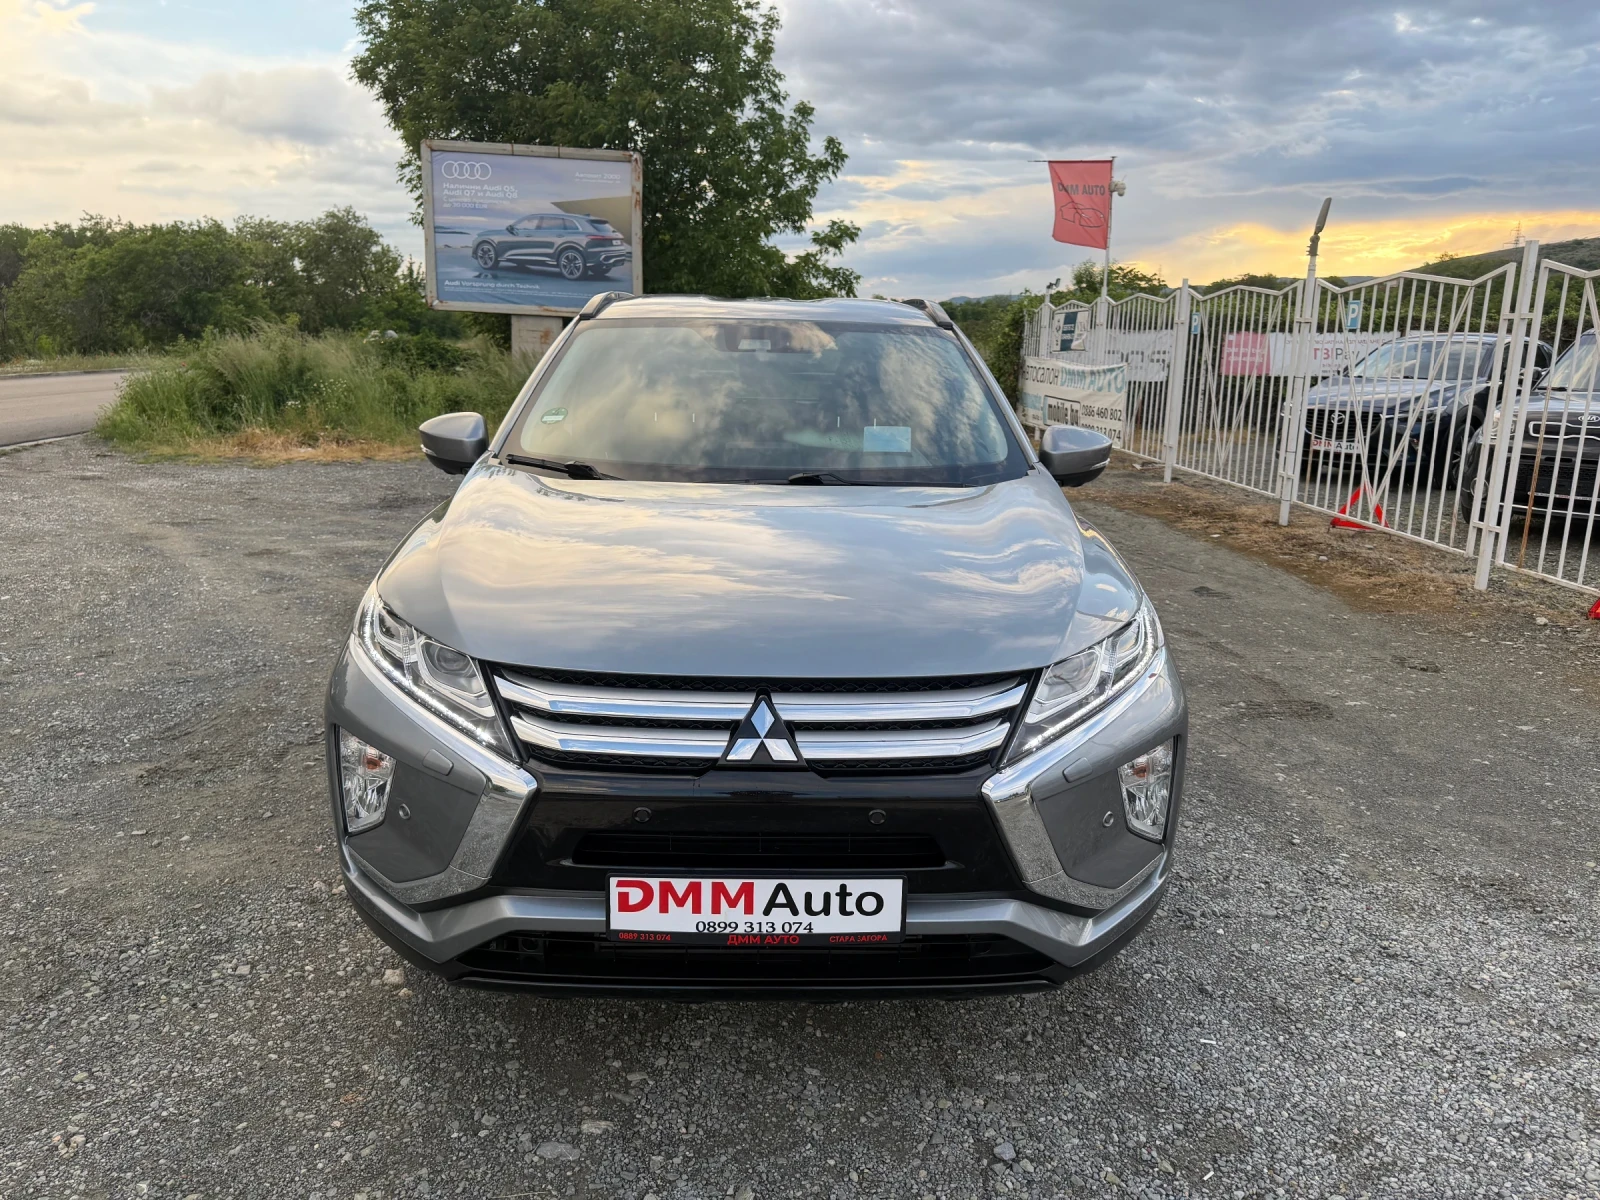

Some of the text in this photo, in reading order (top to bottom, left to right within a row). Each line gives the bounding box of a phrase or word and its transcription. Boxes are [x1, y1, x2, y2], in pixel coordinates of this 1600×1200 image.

[443, 188, 462, 196] Audi
[464, 189, 475, 197] Q7
[485, 190, 504, 198] Audi
[505, 191, 518, 199] Q8
[1082, 184, 1106, 196] AUTO
[460, 280, 496, 288] Vorsprung
[1347, 304, 1359, 326] P
[1192, 315, 1199, 332] P
[1096, 406, 1109, 419] 460
[1109, 408, 1123, 421] 802
[615, 879, 885, 917] DMM Auto
[695, 920, 814, 934] 0899 313 074
[618, 932, 888, 946] 0889 313 074 ДММ АУТО СТАРА ЗАГОРА
